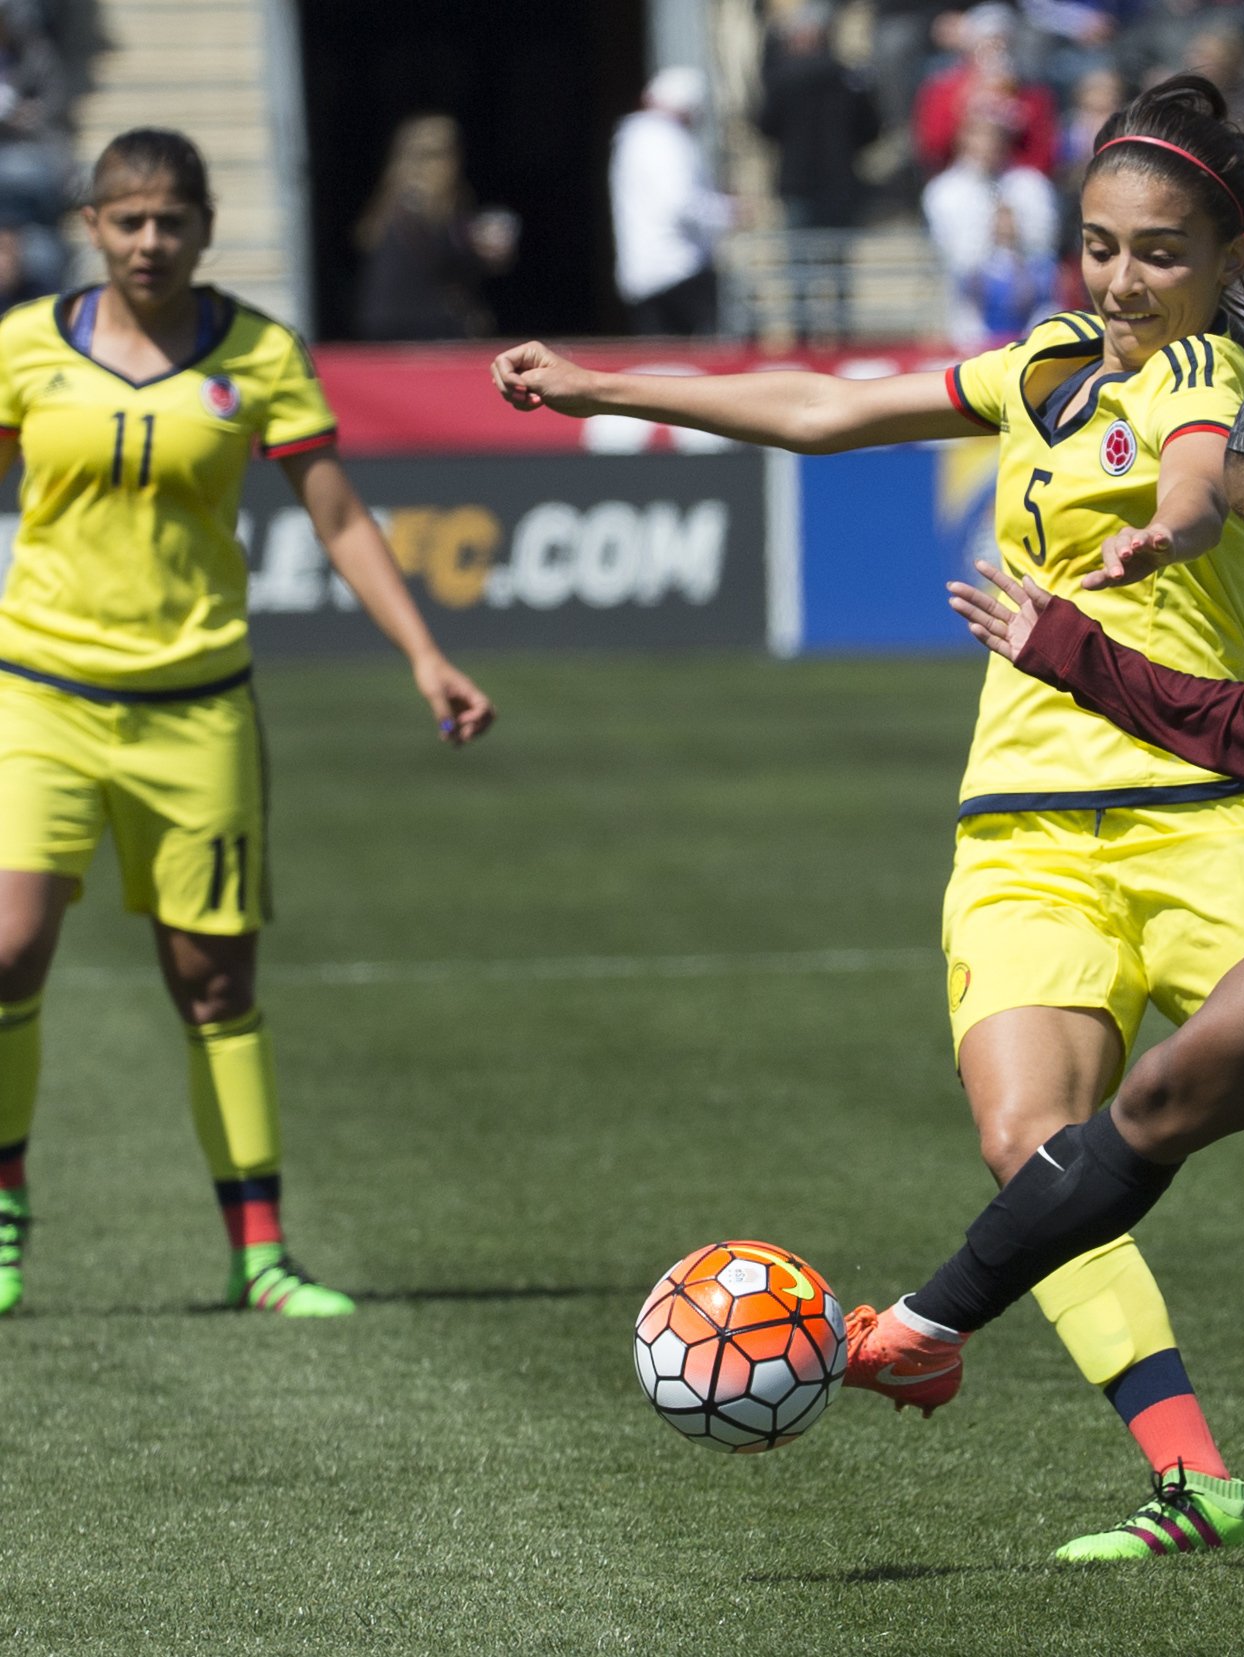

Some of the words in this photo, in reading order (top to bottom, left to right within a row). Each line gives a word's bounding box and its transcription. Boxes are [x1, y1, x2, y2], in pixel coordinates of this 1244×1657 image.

[112, 411, 155, 488] 11
[1023, 467, 1053, 567] 5
[210, 834, 248, 912] 11
